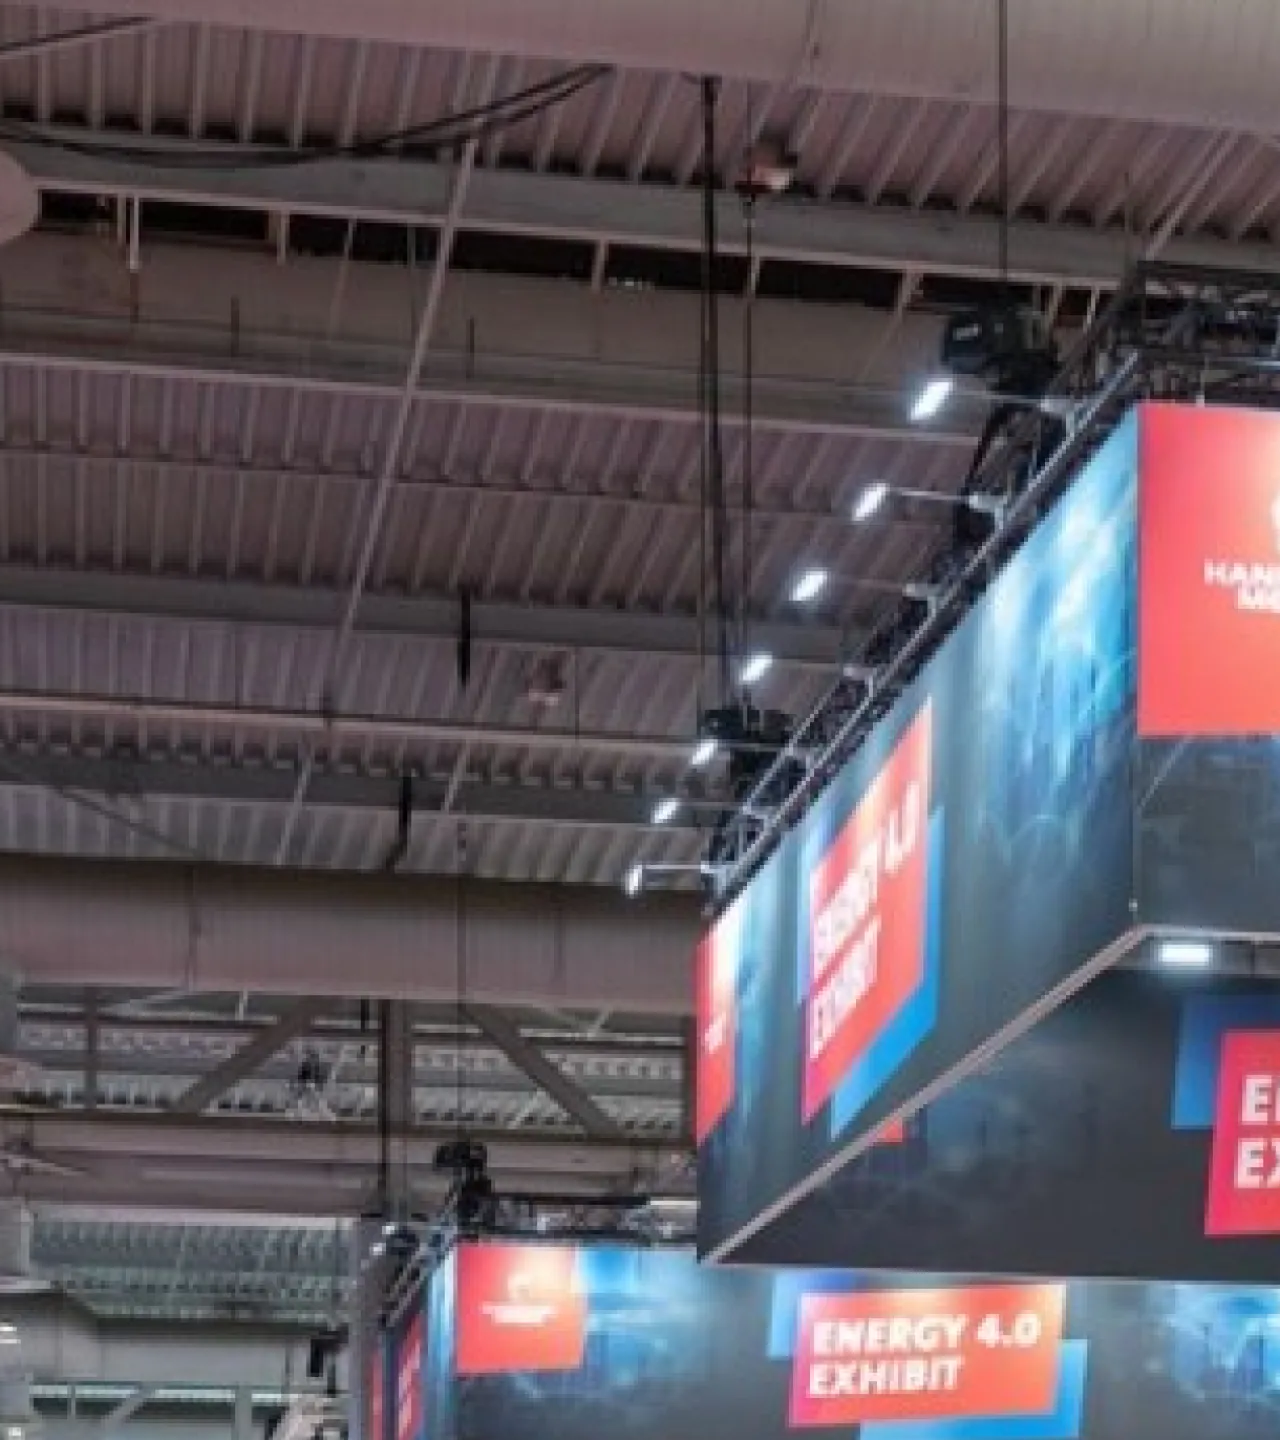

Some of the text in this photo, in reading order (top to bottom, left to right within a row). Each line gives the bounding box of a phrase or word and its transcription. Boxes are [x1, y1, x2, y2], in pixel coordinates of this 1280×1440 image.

[812, 1314, 1042, 1356] ENERGY 4.0
[807, 1357, 964, 1395] EXHIBIT
